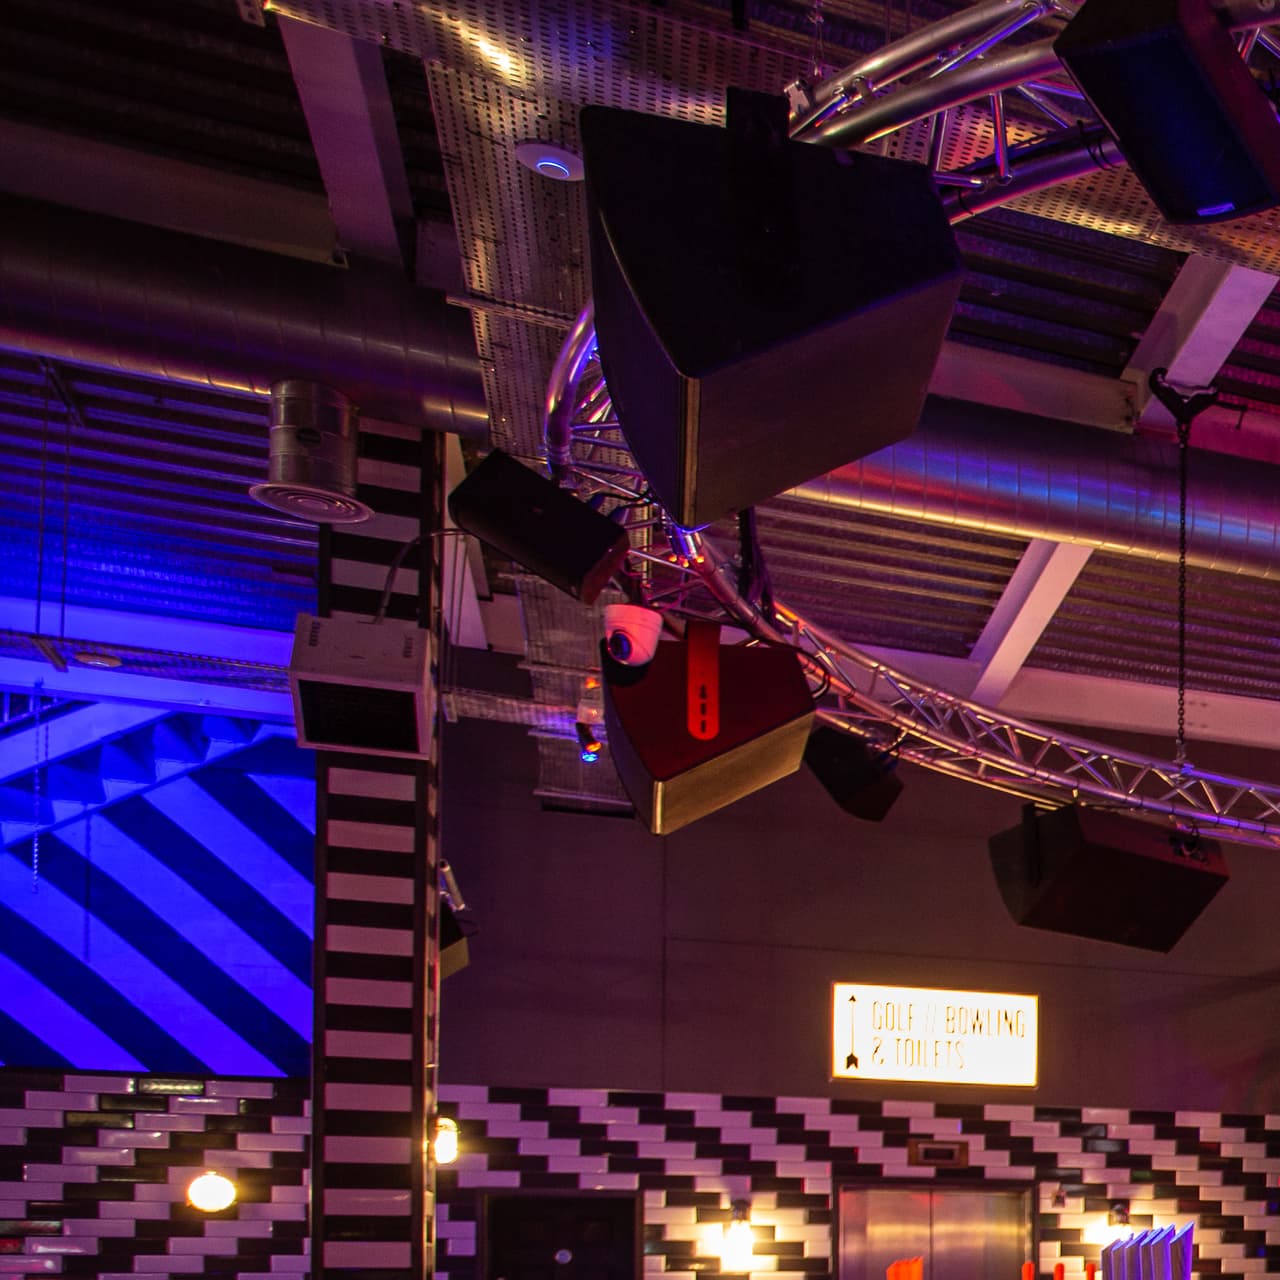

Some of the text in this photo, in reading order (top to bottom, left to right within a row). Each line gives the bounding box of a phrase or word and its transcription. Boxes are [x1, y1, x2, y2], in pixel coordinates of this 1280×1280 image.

[871, 1000, 915, 1032] GOLF
[945, 1004, 1026, 1038] BOWLING
[870, 1036, 966, 1069] & TOILETS
